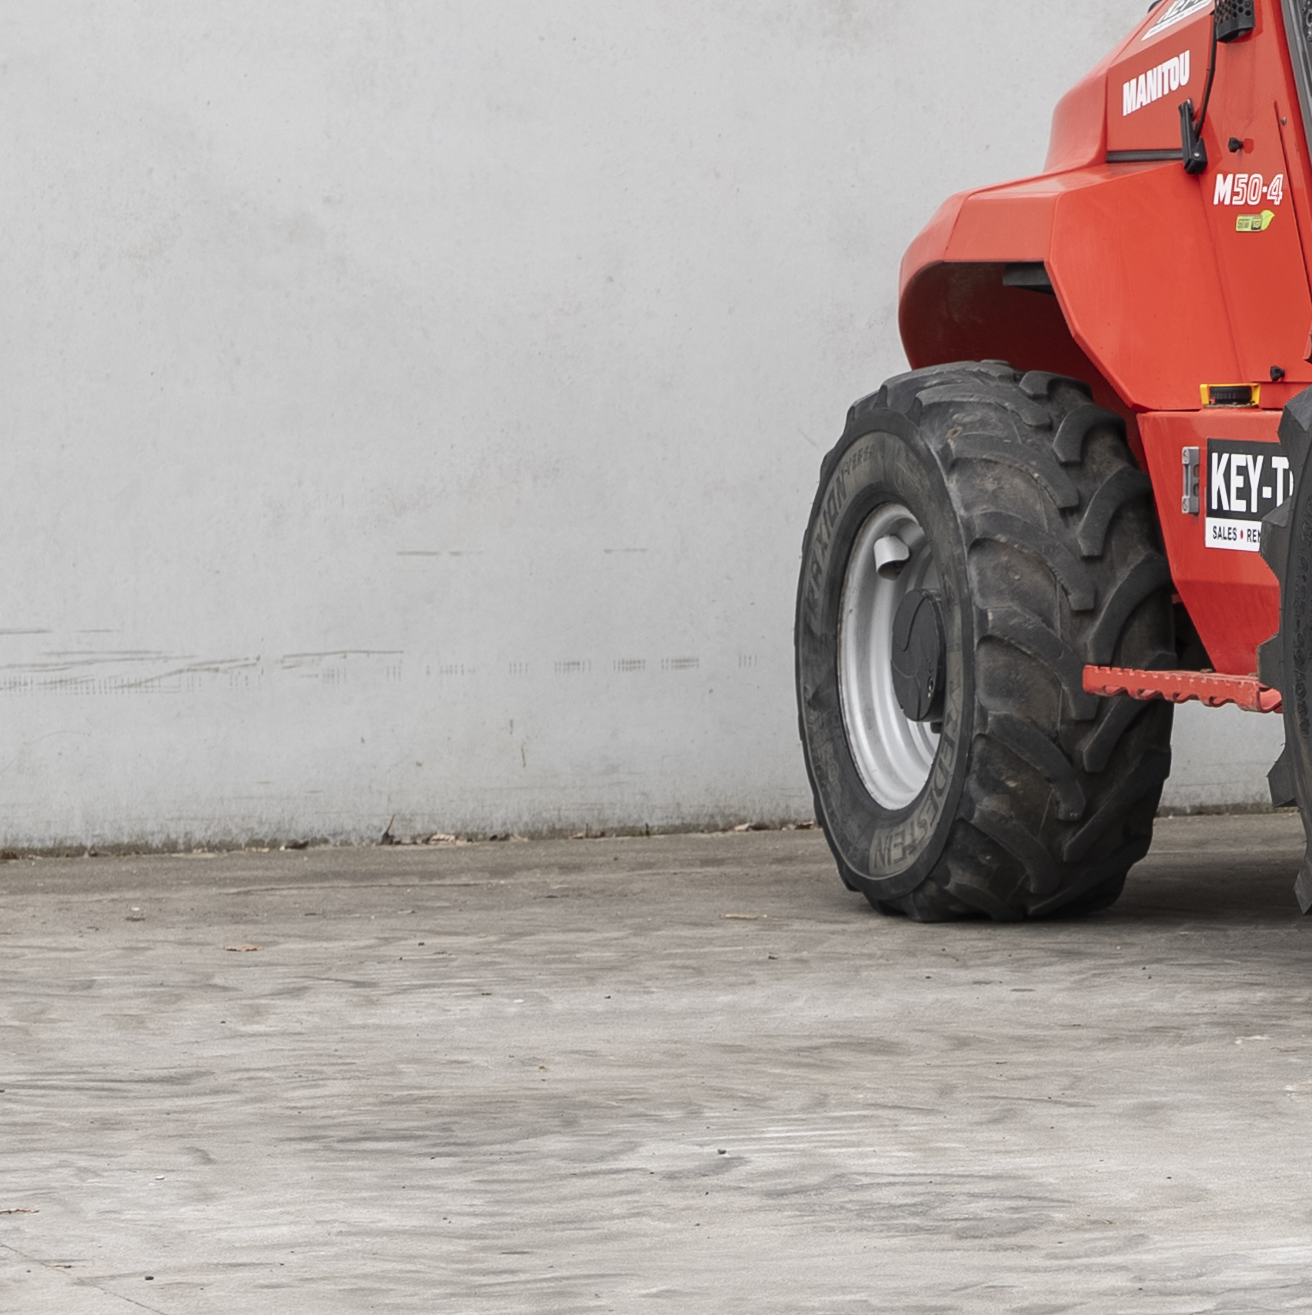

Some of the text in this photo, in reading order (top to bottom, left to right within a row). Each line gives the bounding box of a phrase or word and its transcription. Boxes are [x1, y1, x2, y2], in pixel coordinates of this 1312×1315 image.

[1122, 49, 1191, 117] MANITOU
[1211, 452, 1294, 513] KEY-T
[1212, 525, 1237, 542] SALES
